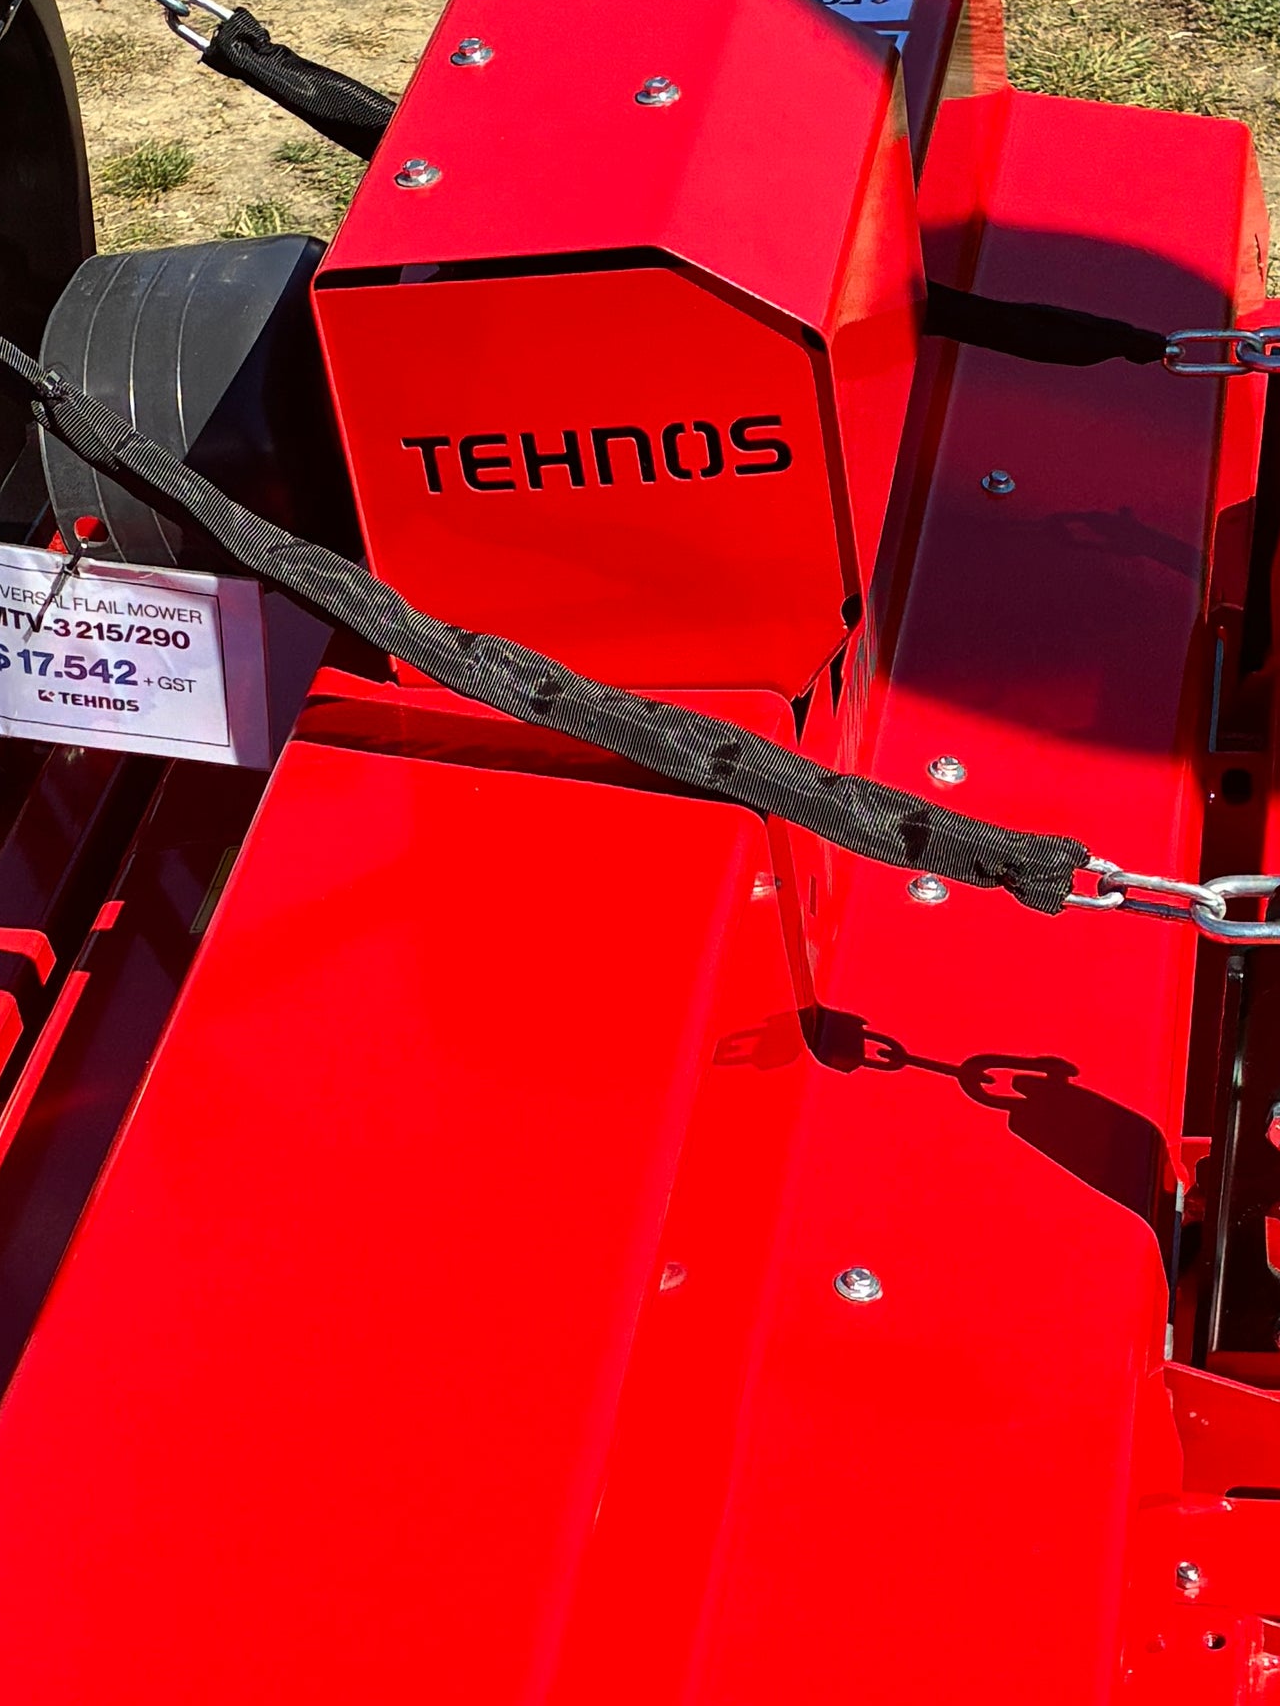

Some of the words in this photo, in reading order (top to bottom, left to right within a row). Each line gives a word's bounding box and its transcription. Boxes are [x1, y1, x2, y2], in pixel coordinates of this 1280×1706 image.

[400, 414, 794, 495] TEHNOS
[73, 597, 124, 615] FLAIL
[127, 603, 203, 624] MOWER
[75, 621, 191, 650] 215/290
[157, 677, 197, 694] GST
[58, 692, 140, 712] TEHNOS
